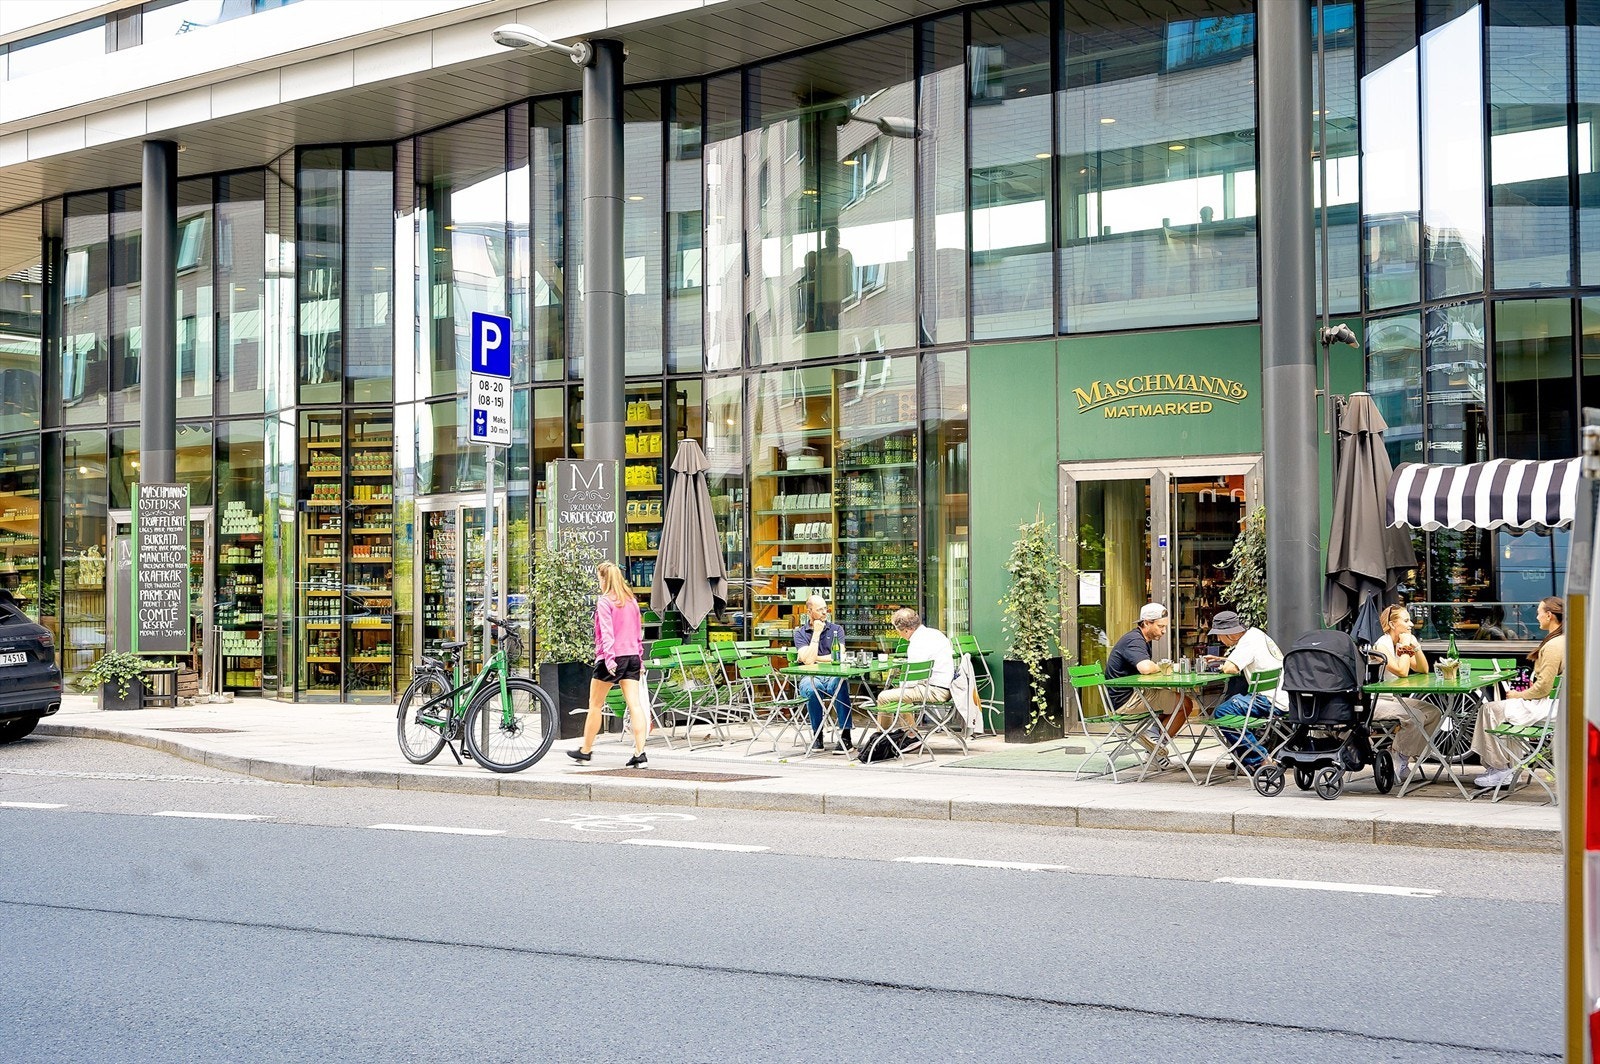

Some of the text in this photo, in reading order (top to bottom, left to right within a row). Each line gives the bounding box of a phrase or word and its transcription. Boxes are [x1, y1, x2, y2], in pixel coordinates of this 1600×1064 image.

[481, 320, 502, 366] P
[479, 380, 504, 393] 08-20
[478, 394, 504, 408] (08-15)
[1104, 401, 1213, 419] MATMARKED
[492, 415, 506, 424] Maks
[490, 425, 509, 435] 30 min
[570, 463, 604, 491] M
[139, 499, 181, 510] OSTEDISK
[144, 533, 178, 545] BURRATA
[139, 552, 182, 563] MANCHEGO
[139, 570, 183, 583] KRAFTKAR
[139, 589, 181, 601] PARMESAN
[142, 621, 175, 629] RESERVE
